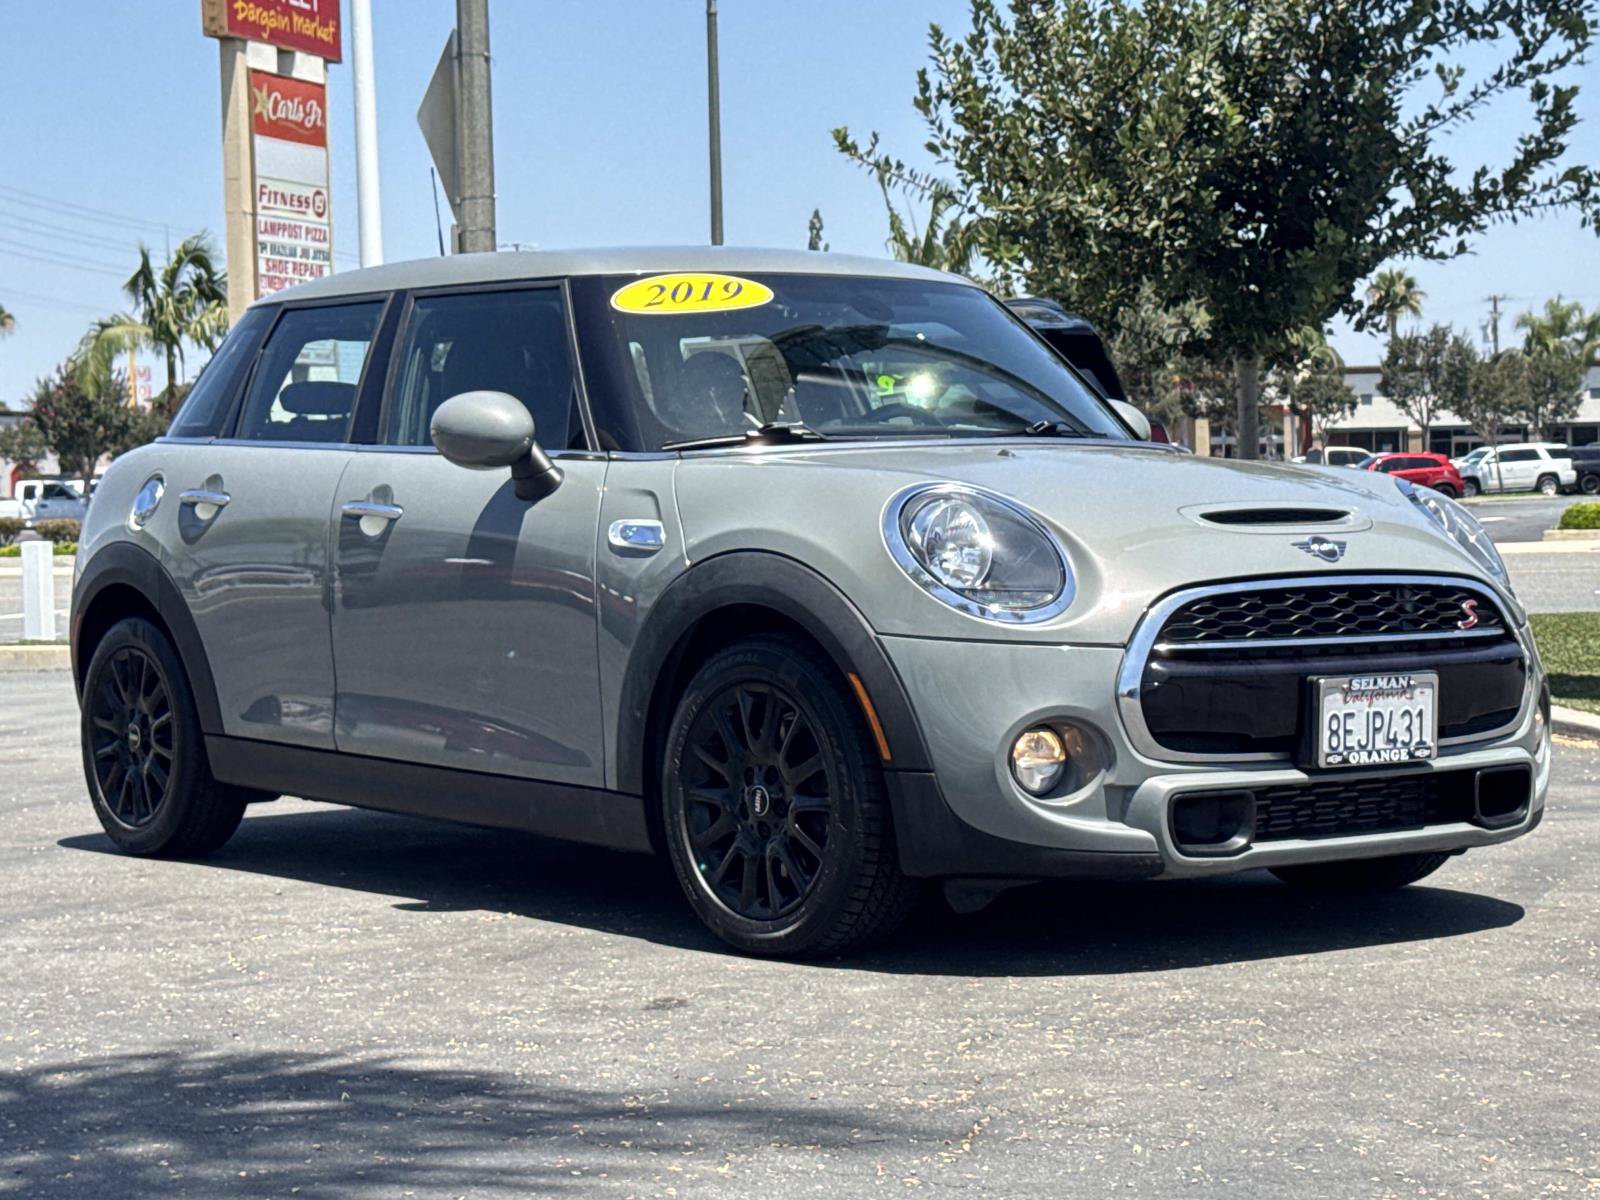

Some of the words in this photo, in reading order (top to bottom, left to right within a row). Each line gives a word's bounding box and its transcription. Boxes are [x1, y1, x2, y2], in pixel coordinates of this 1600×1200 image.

[268, 91, 304, 122] Carl's
[259, 220, 303, 240] LAMPPOST
[304, 226, 327, 243] PIZZA
[265, 258, 289, 275] SHOE
[292, 260, 324, 278] REPAIR
[644, 281, 743, 307] 2019
[1457, 598, 1478, 629] S
[1351, 677, 1409, 690] SELMAN
[1342, 689, 1414, 707] California
[1327, 708, 1428, 752] 8EJP431
[1348, 748, 1410, 764] ORANGE
